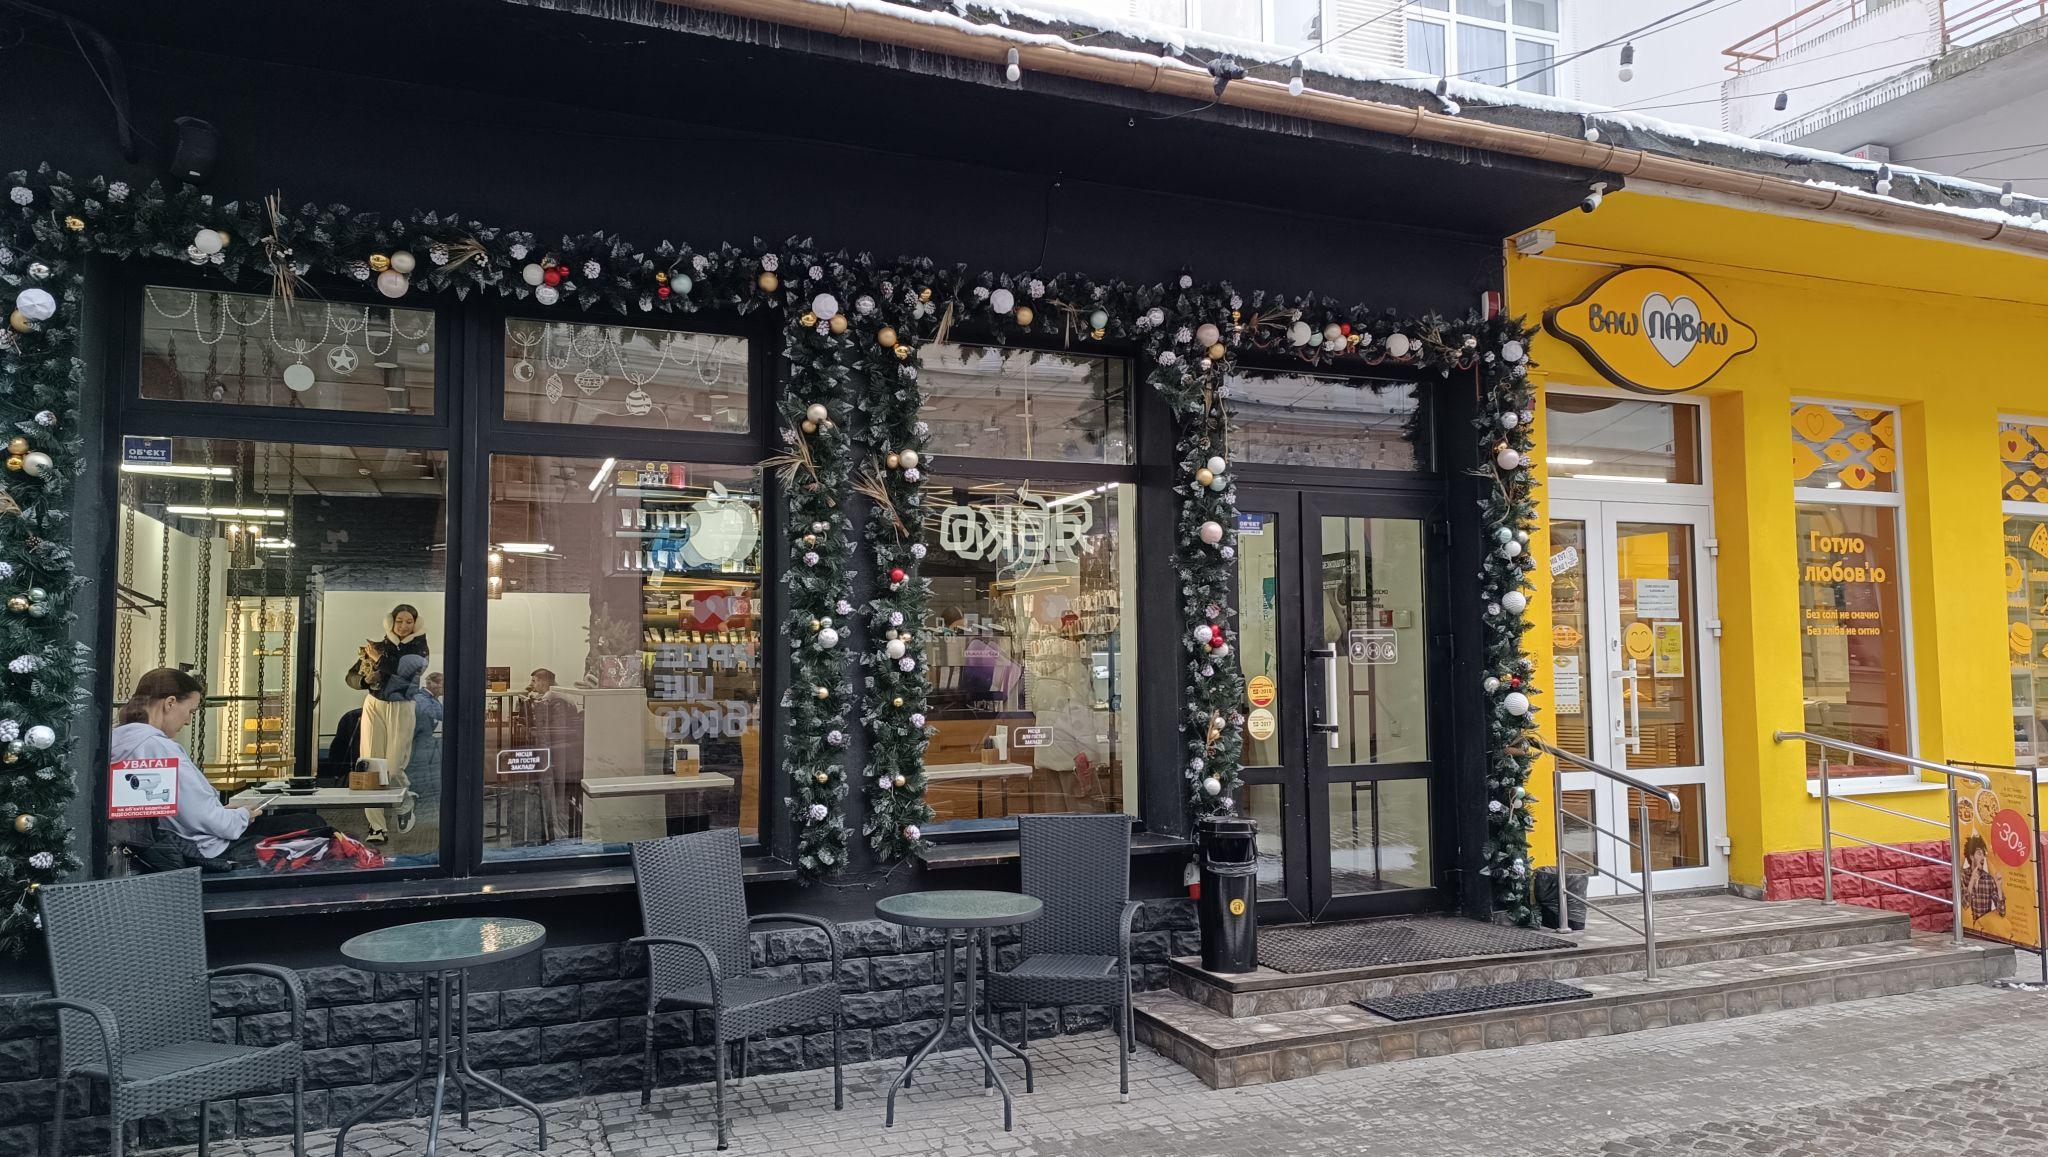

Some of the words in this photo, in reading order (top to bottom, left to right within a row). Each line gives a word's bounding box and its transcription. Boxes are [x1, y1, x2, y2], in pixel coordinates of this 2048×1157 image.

[1810, 530, 1865, 555] Готую
[1804, 560, 1886, 583] любов'ю
[1806, 609, 1820, 620] Без
[1822, 609, 1838, 620] солі
[1839, 611, 1849, 620] не
[1851, 611, 1879, 620] смачно
[1807, 626, 1821, 636] Без
[1823, 626, 1845, 636] хліба
[1846, 627, 1856, 636] не
[1858, 626, 1880, 636] ситно
[122, 759, 168, 769] УВАГА!
[1997, 822, 2026, 856] -30%
